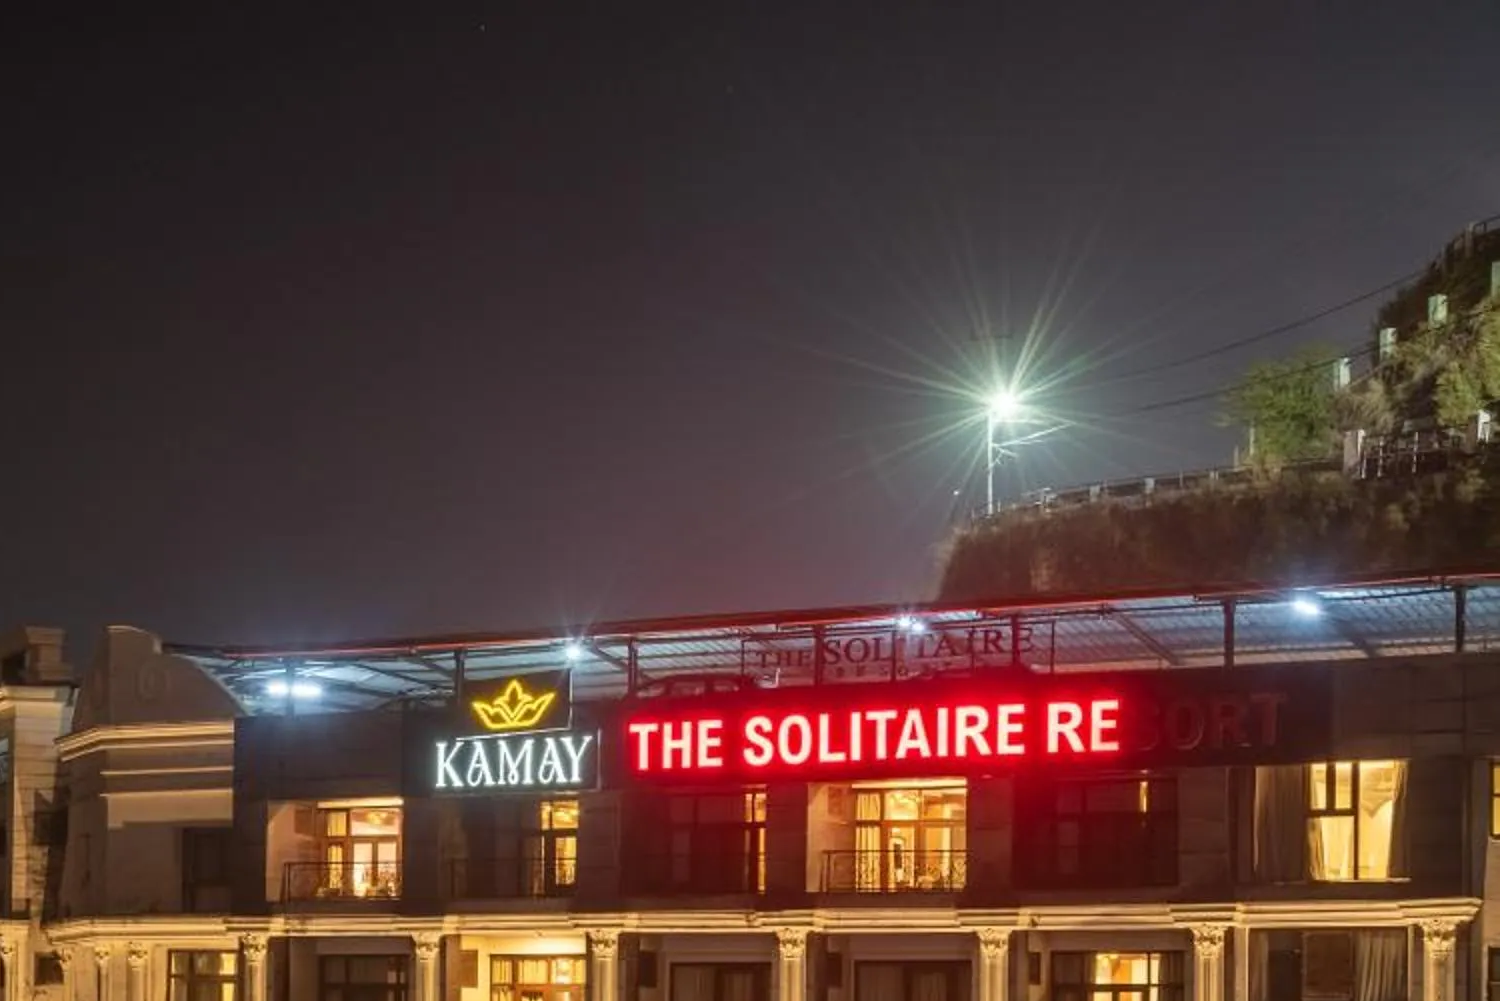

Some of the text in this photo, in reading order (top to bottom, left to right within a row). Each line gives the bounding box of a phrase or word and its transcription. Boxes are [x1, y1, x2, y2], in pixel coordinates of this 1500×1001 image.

[755, 649, 812, 669] THE
[435, 735, 593, 788] KAMAY
[628, 719, 723, 771] THE
[743, 703, 1026, 767] SOLITAIRE
